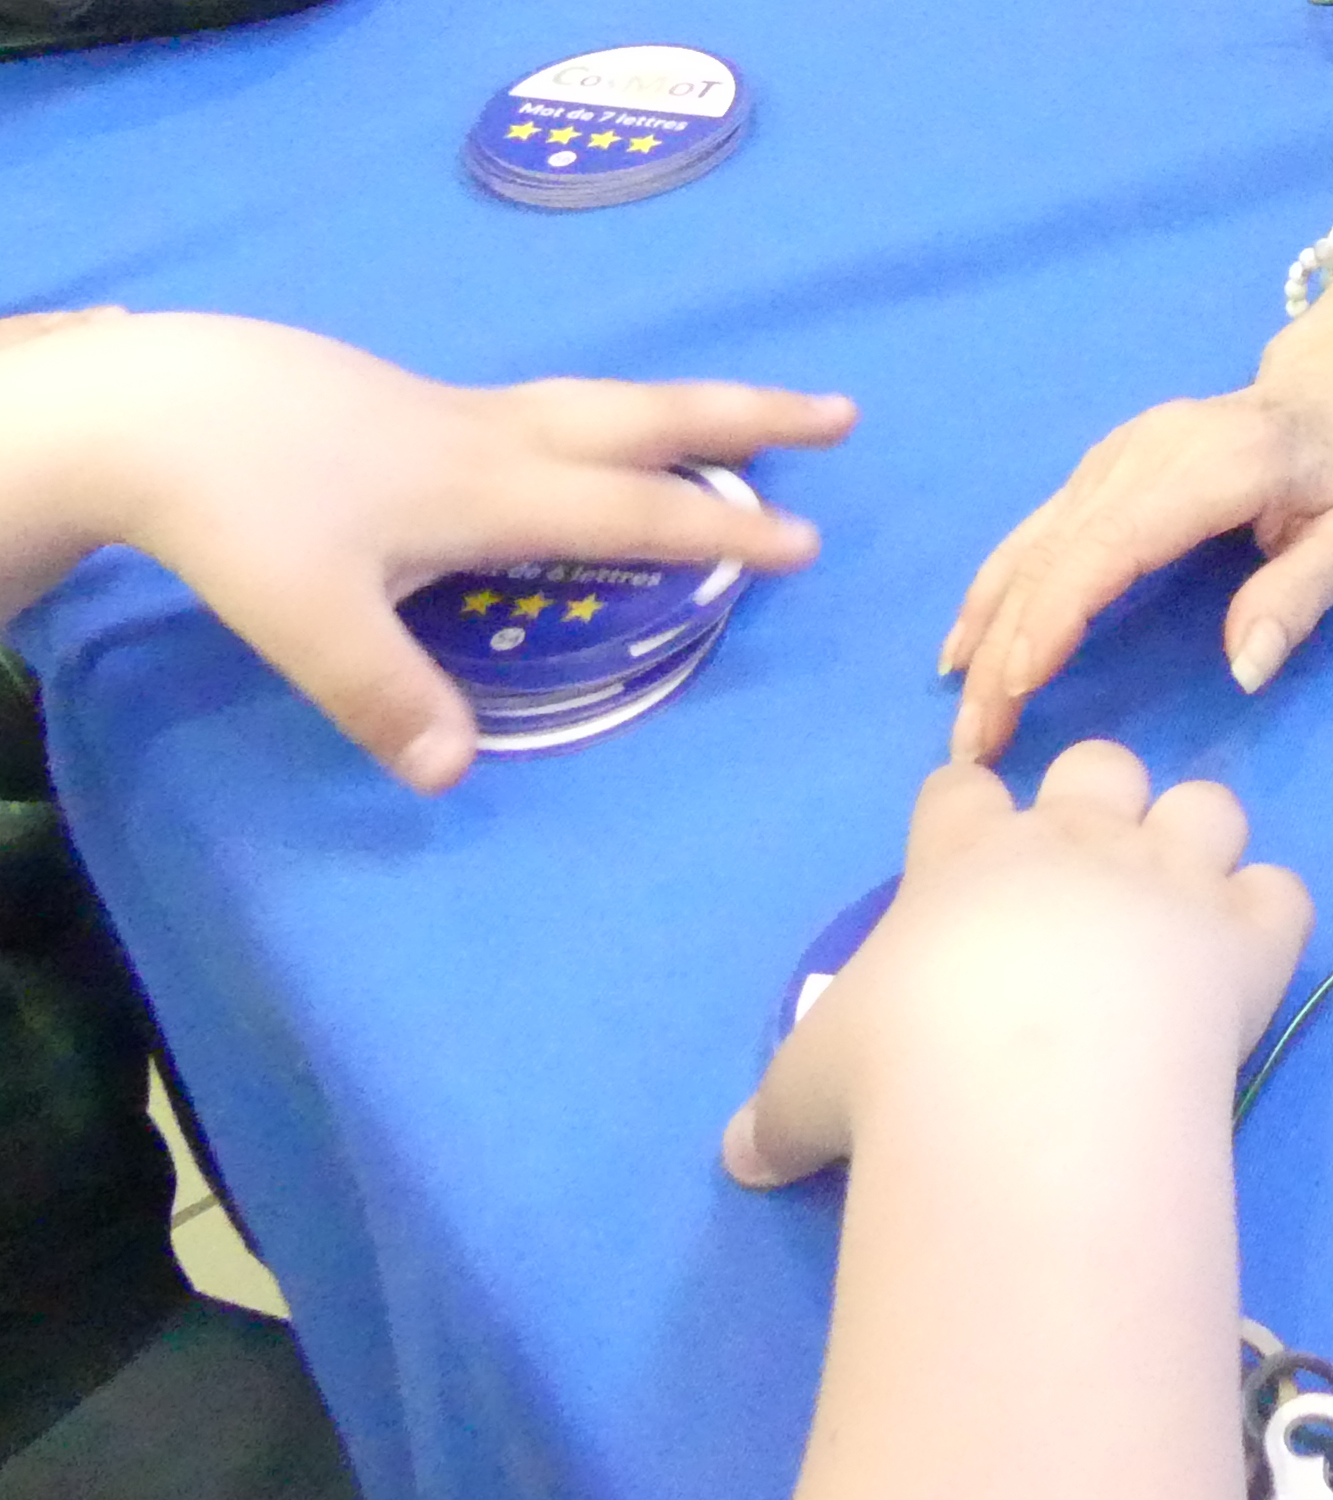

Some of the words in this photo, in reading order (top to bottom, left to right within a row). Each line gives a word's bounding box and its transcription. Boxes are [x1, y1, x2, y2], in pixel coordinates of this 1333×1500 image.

[518, 102, 564, 119] Mot
[566, 106, 595, 122] de
[598, 111, 615, 124] 7
[615, 113, 689, 132] lettres
